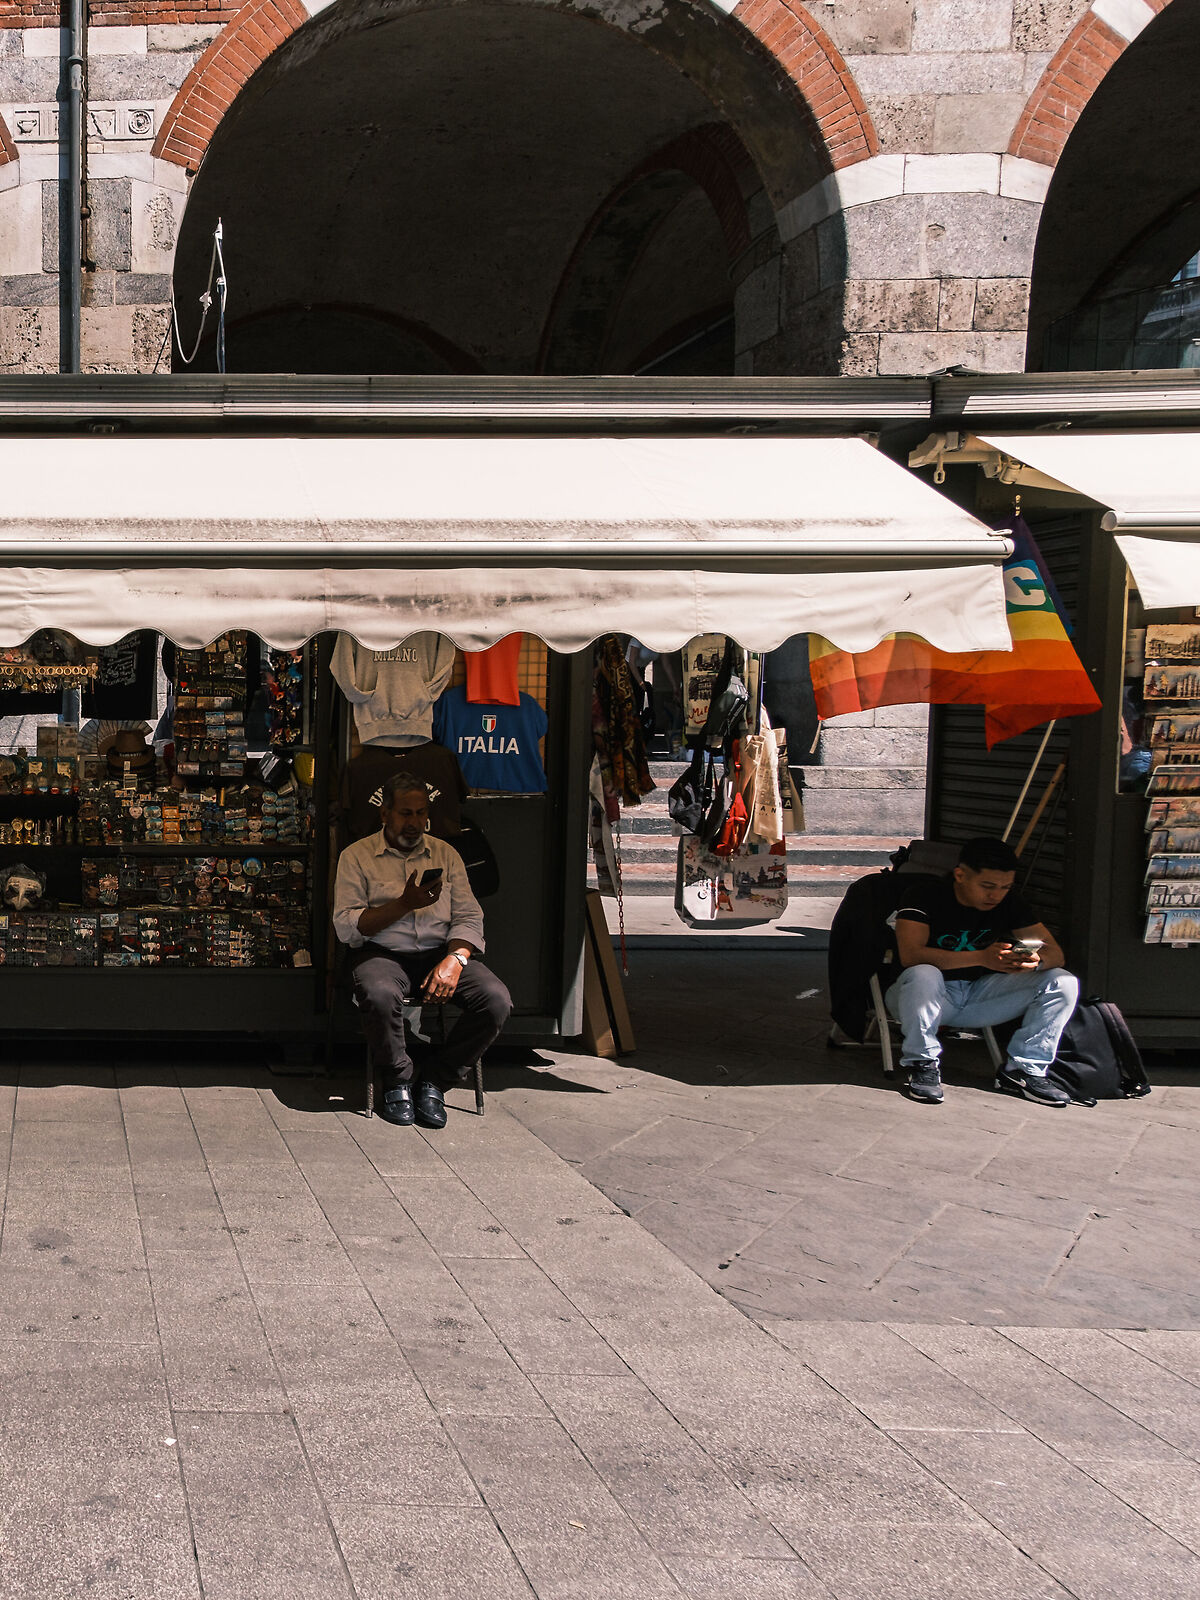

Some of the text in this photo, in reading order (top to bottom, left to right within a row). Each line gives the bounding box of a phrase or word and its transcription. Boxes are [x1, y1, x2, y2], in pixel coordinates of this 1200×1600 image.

[373, 647, 418, 662] MILANO
[688, 705, 710, 720] Mil
[457, 736, 520, 755] ITALIA
[1156, 893, 1200, 905] ITAL
